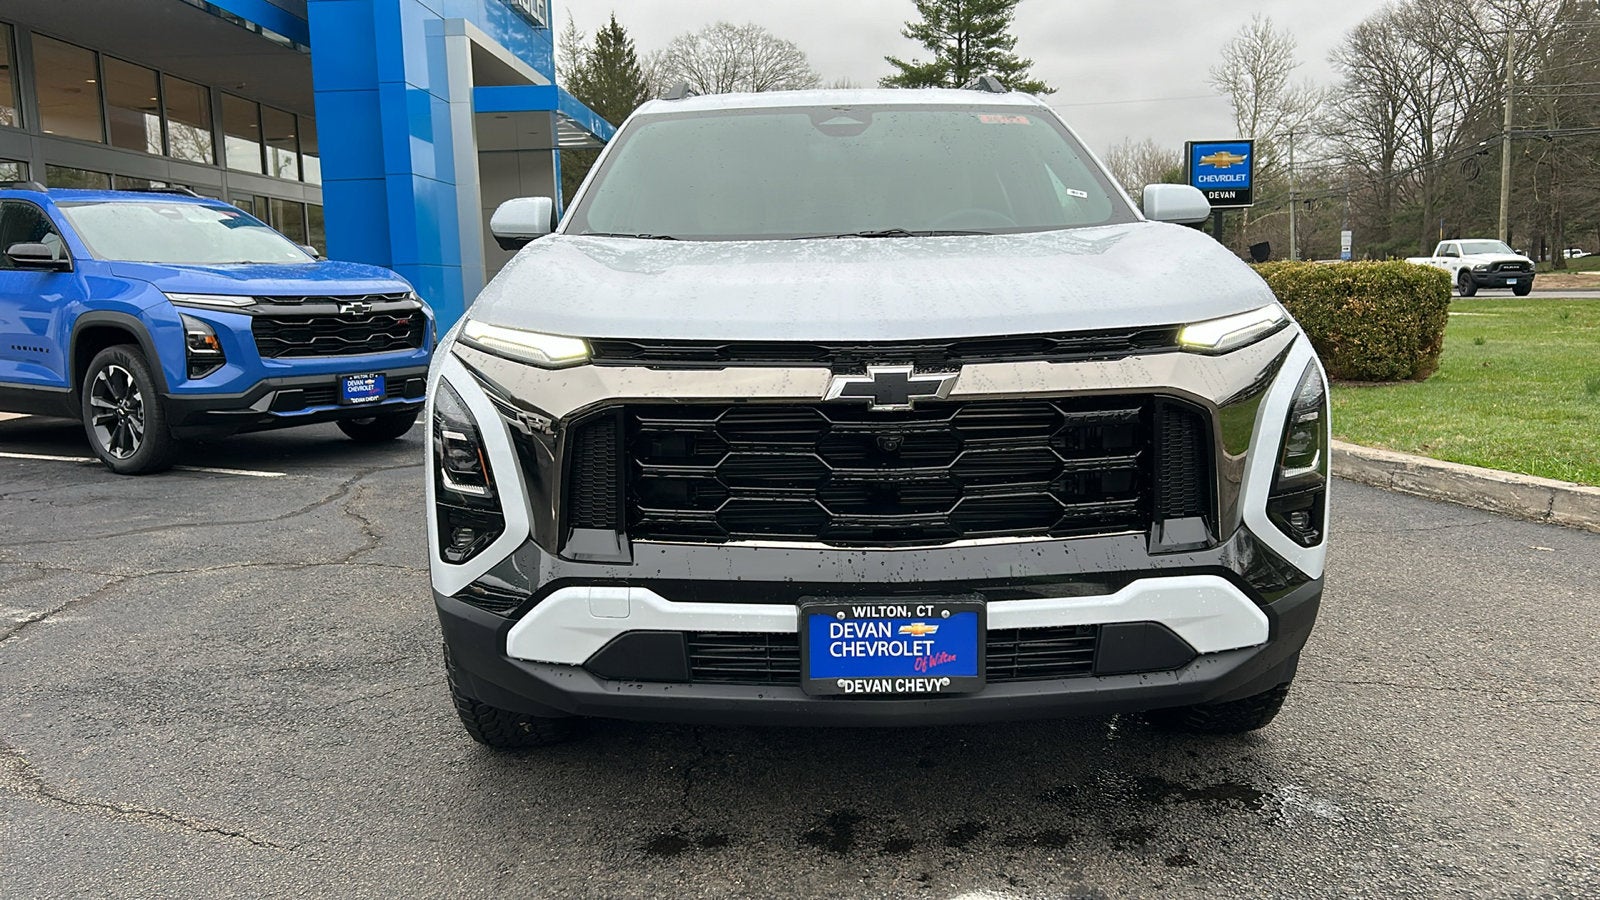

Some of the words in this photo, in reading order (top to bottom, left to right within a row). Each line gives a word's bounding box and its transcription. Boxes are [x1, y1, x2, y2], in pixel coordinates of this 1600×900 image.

[1198, 174, 1246, 182] CHEVROLET
[1208, 191, 1236, 199] DEVAN
[852, 605, 911, 618] WILTON,
[916, 605, 934, 617] CT
[830, 622, 891, 638] DEVAN
[830, 640, 934, 658] CHEVROLET
[914, 657, 927, 673] Of
[929, 651, 957, 668] Wilton
[844, 679, 892, 693] DEVAN
[895, 678, 942, 692] CHEVY
